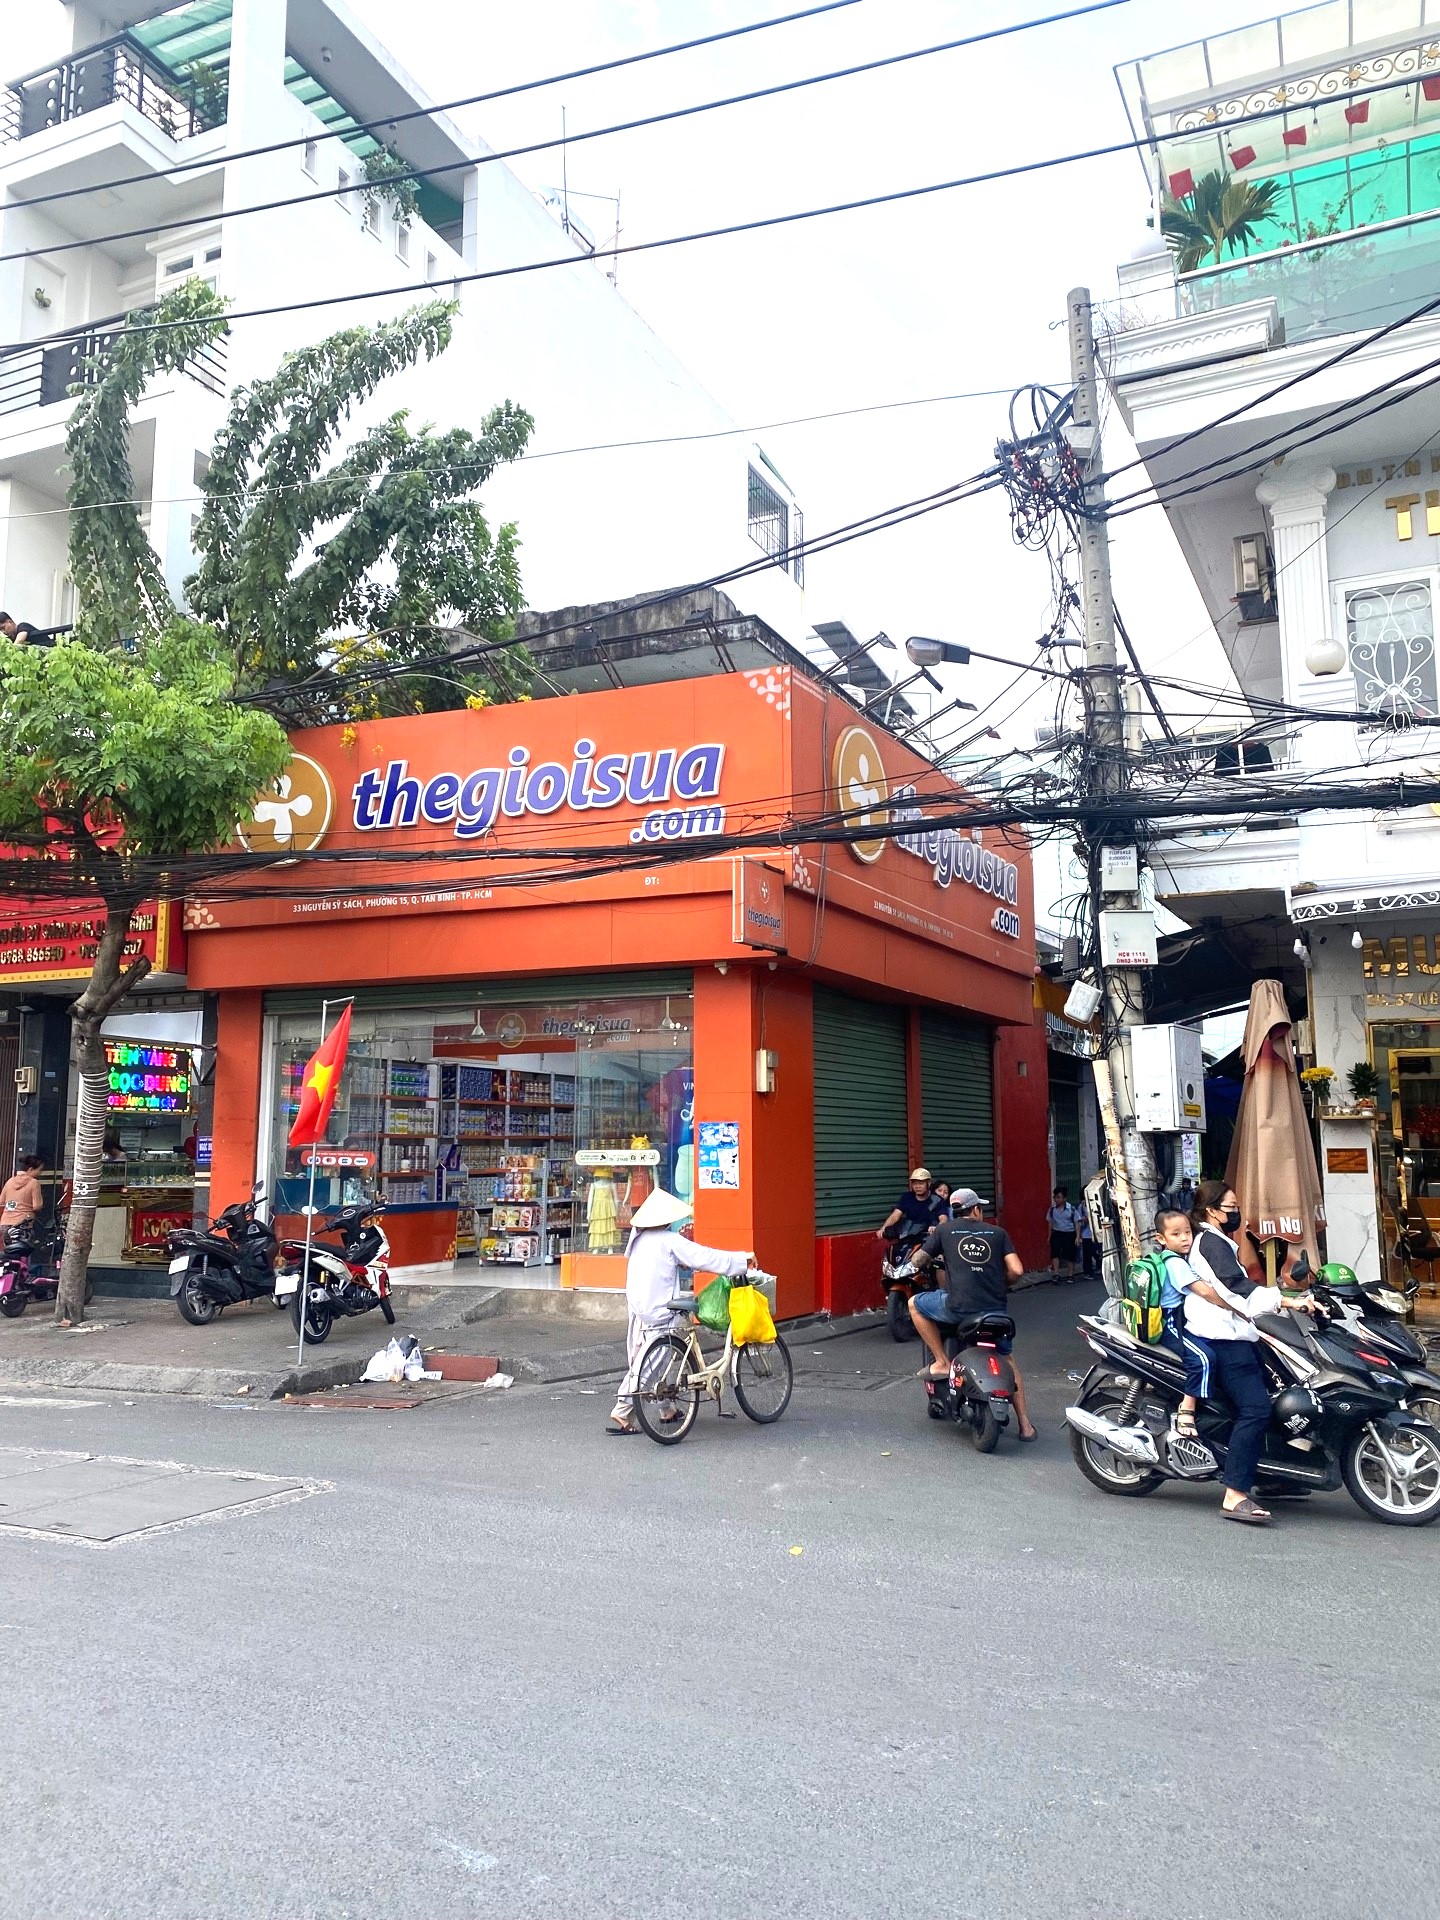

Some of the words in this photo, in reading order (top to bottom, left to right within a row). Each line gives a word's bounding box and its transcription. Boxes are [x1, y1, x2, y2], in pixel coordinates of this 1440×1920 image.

[352, 738, 726, 838] thegioisua
[629, 804, 726, 843] .com
[891, 783, 1018, 907] thegioisua
[293, 904, 301, 912] 33
[399, 897, 409, 906] 15,
[411, 896, 420, 905] Q.
[462, 891, 472, 900] TP.
[474, 890, 492, 899] HCM
[990, 906, 1020, 940] .com
[108, 1071, 140, 1094] GỌC
[73, 1183, 89, 1195] 53
